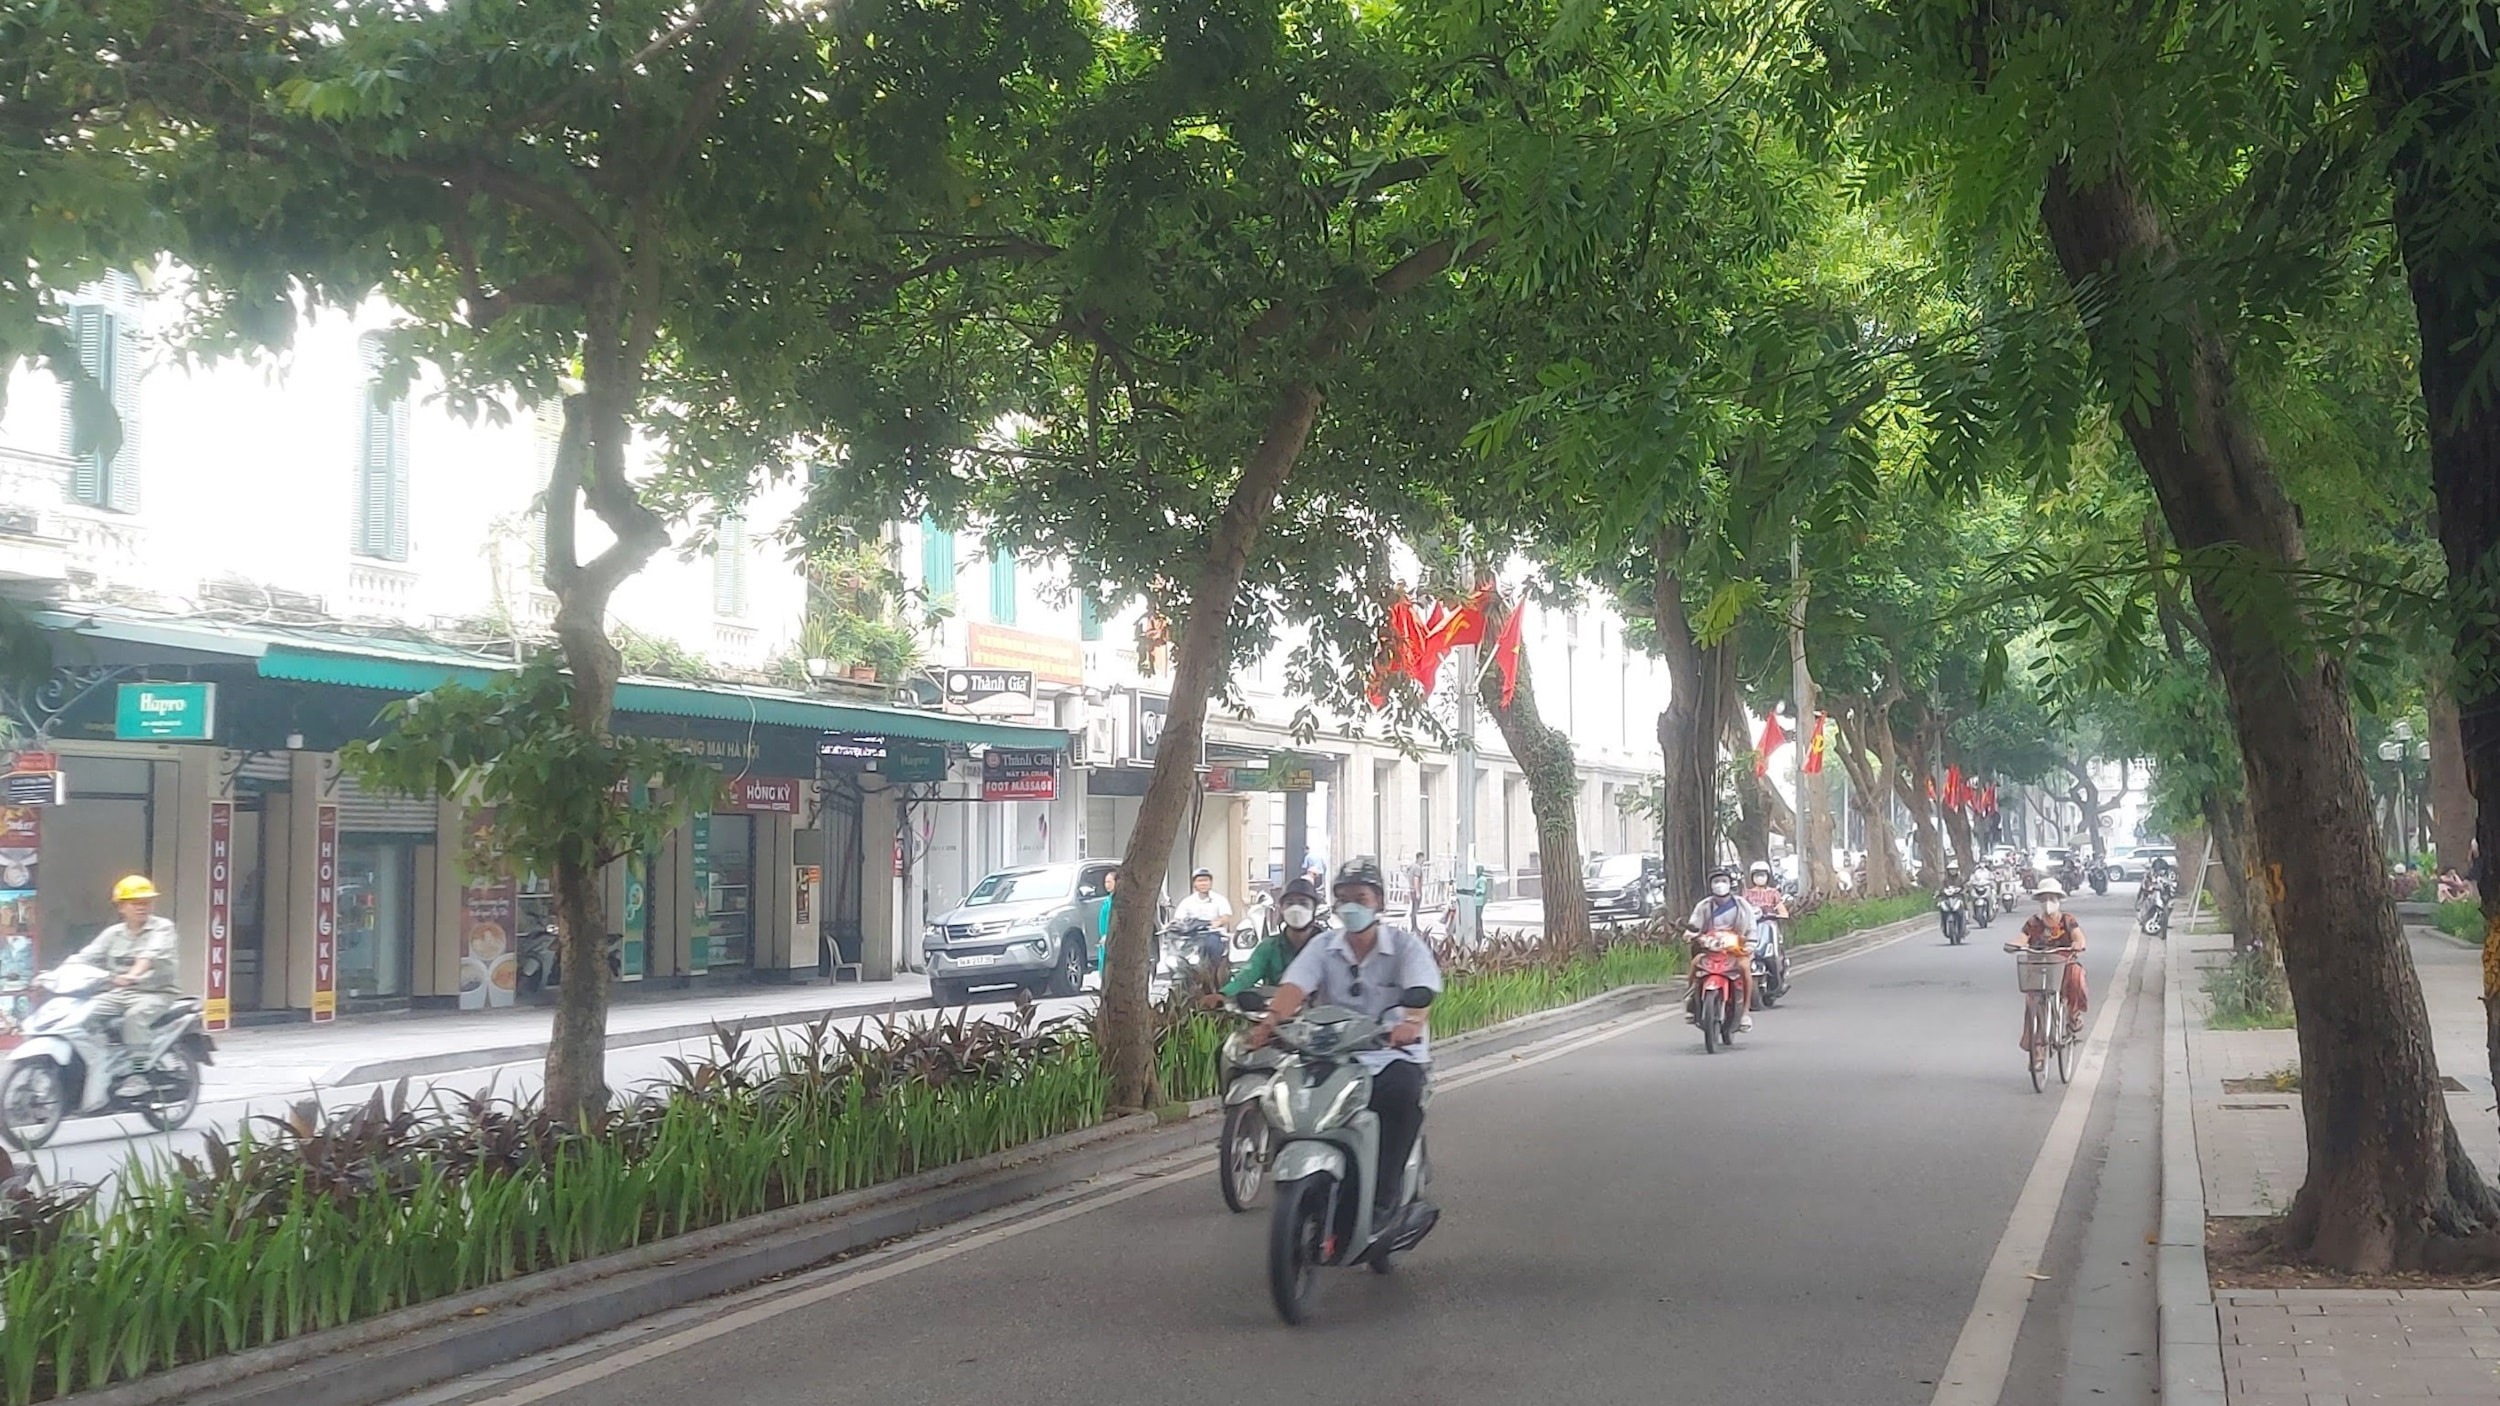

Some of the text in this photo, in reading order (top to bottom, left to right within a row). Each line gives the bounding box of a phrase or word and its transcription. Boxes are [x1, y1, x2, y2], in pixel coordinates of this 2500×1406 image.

[140, 692, 186, 716] Hapro
[727, 739, 741, 757] HÀ
[746, 779, 776, 800] HỒNG
[777, 783, 791, 802] KỲ
[985, 780, 1053, 792] FOOT MASSAGE
